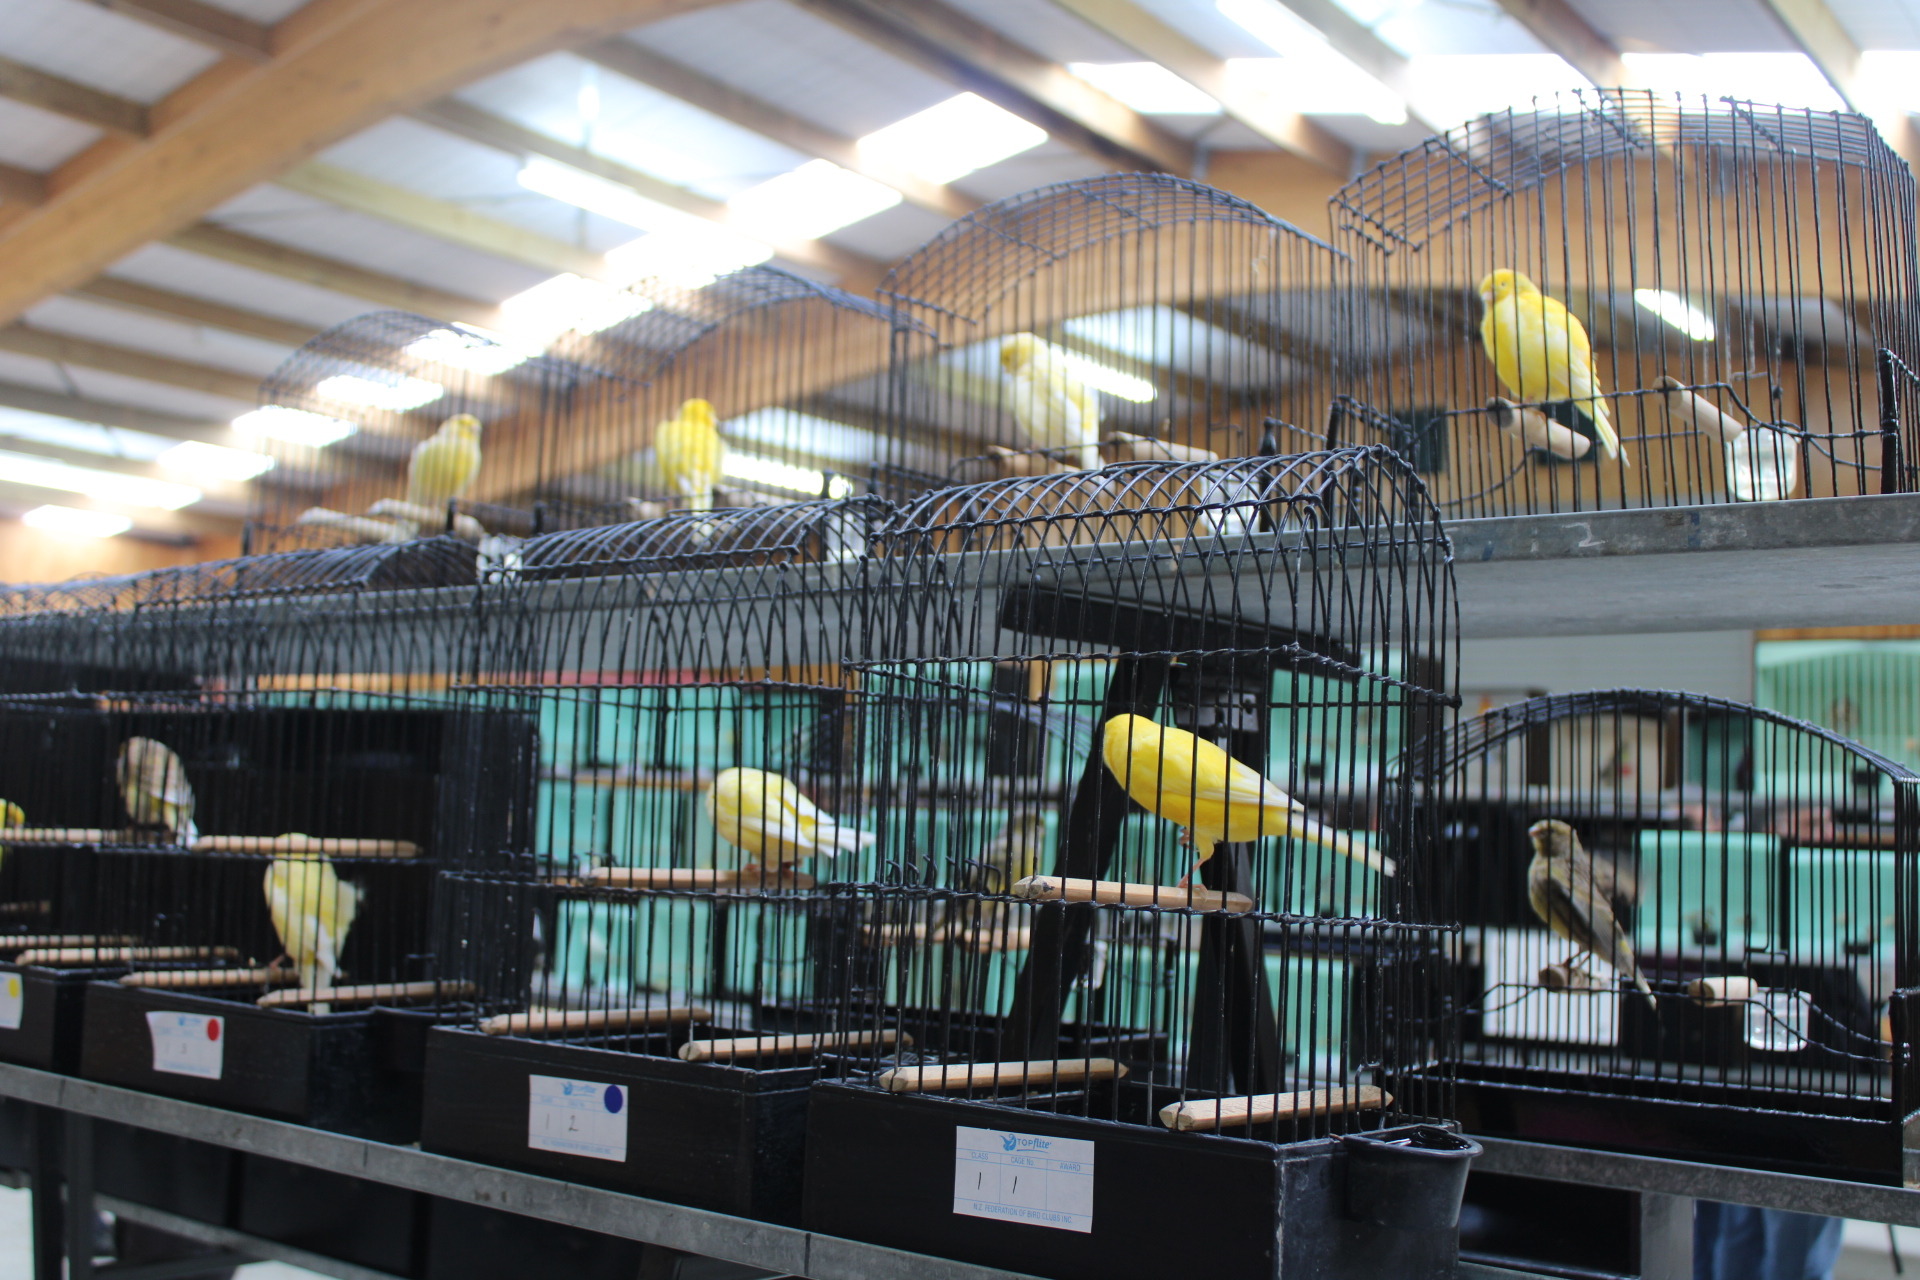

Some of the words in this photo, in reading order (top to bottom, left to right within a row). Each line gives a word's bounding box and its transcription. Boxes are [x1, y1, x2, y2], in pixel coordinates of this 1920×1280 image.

[568, 1115, 579, 1132] 2
[971, 1151, 988, 1160] CLASS
[1010, 1156, 1024, 1165] CAGE
[1060, 1162, 1081, 1171] AWARD
[977, 1171, 982, 1190] 1
[1012, 1175, 1018, 1194] 1
[985, 1204, 1018, 1216] FEDERATION
[1019, 1209, 1026, 1217] OF
[1027, 1210, 1040, 1219] BIRD
[1042, 1212, 1060, 1222] CLUBS
